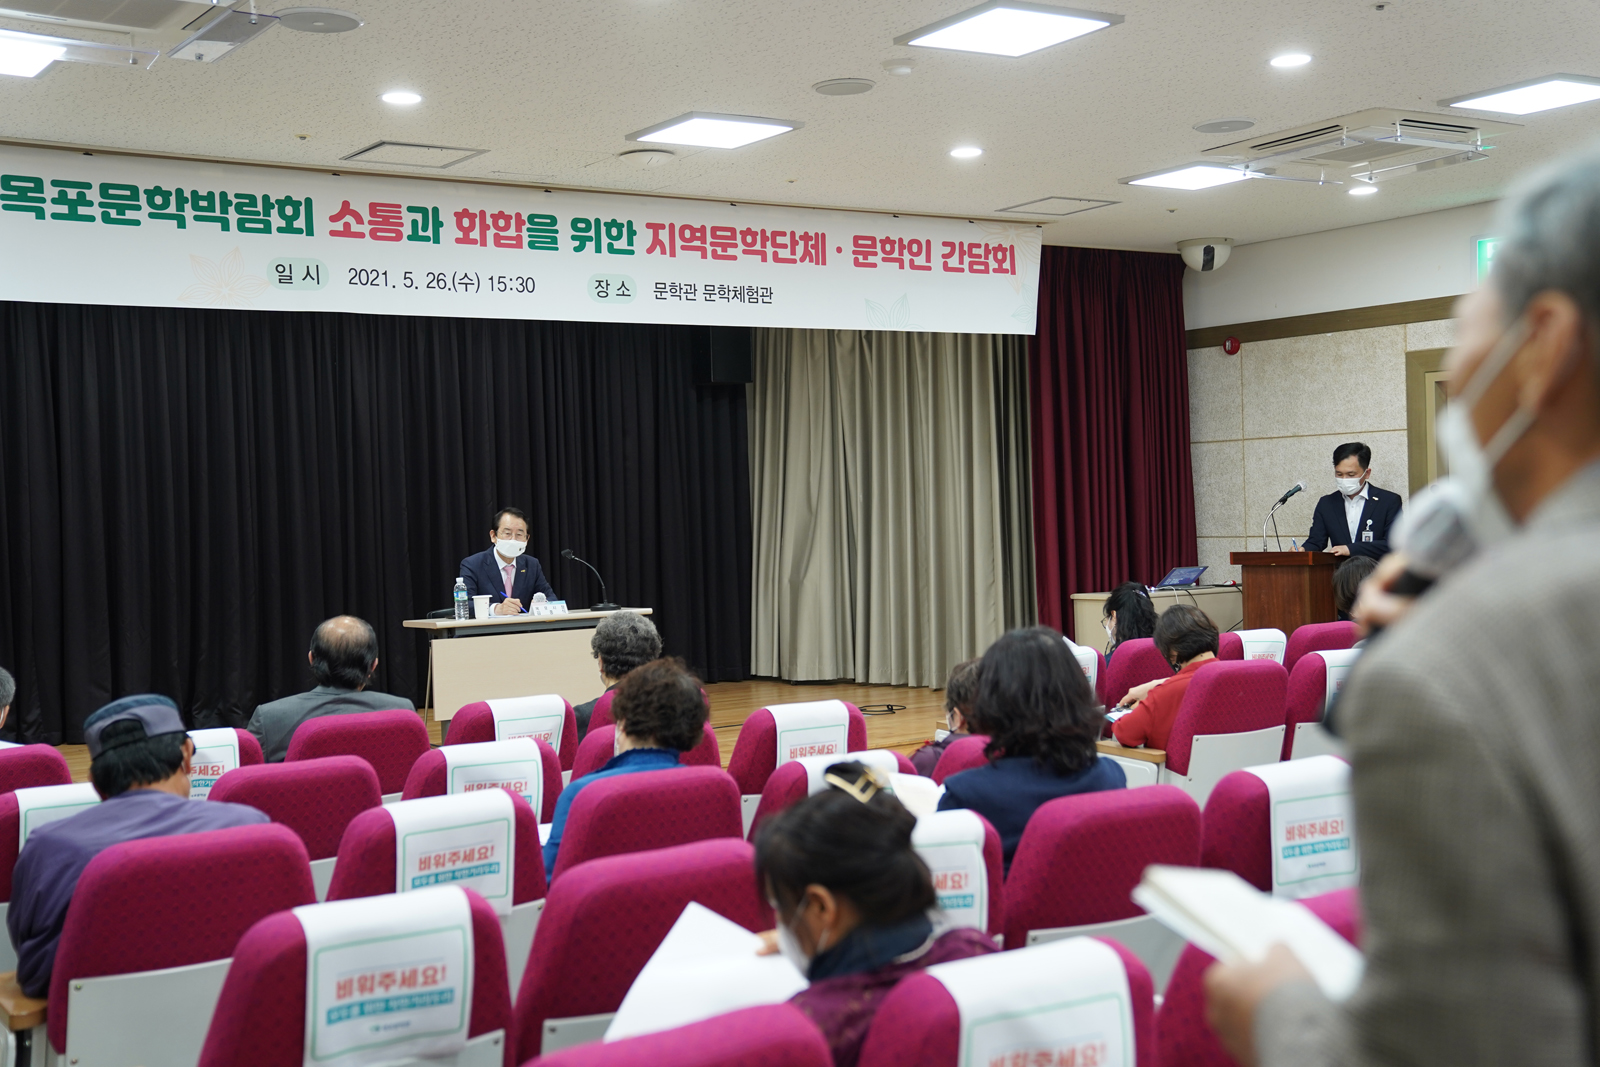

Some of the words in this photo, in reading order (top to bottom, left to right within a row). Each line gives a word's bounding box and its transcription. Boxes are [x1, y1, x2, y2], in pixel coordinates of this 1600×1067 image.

[0, 174, 315, 237] 목포문학박람회
[328, 199, 444, 245] 소통과
[453, 207, 560, 252] 화합을
[570, 217, 637, 256] 위한
[645, 221, 827, 266] 지역문학단체
[852, 234, 933, 271] 문학인
[941, 240, 1016, 276] 간담회
[348, 267, 396, 289] 2021.
[403, 271, 419, 290] 5.
[426, 271, 481, 294] 26.(수)
[488, 275, 536, 294] 15:30
[653, 281, 698, 302] 문학관
[702, 284, 774, 304] 문학체험관
[789, 743, 838, 760] 비워주세요!
[1285, 819, 1344, 842] 비워주세요!
[418, 845, 495, 872] 비워주세요!
[336, 964, 446, 1001] 비워주세요!
